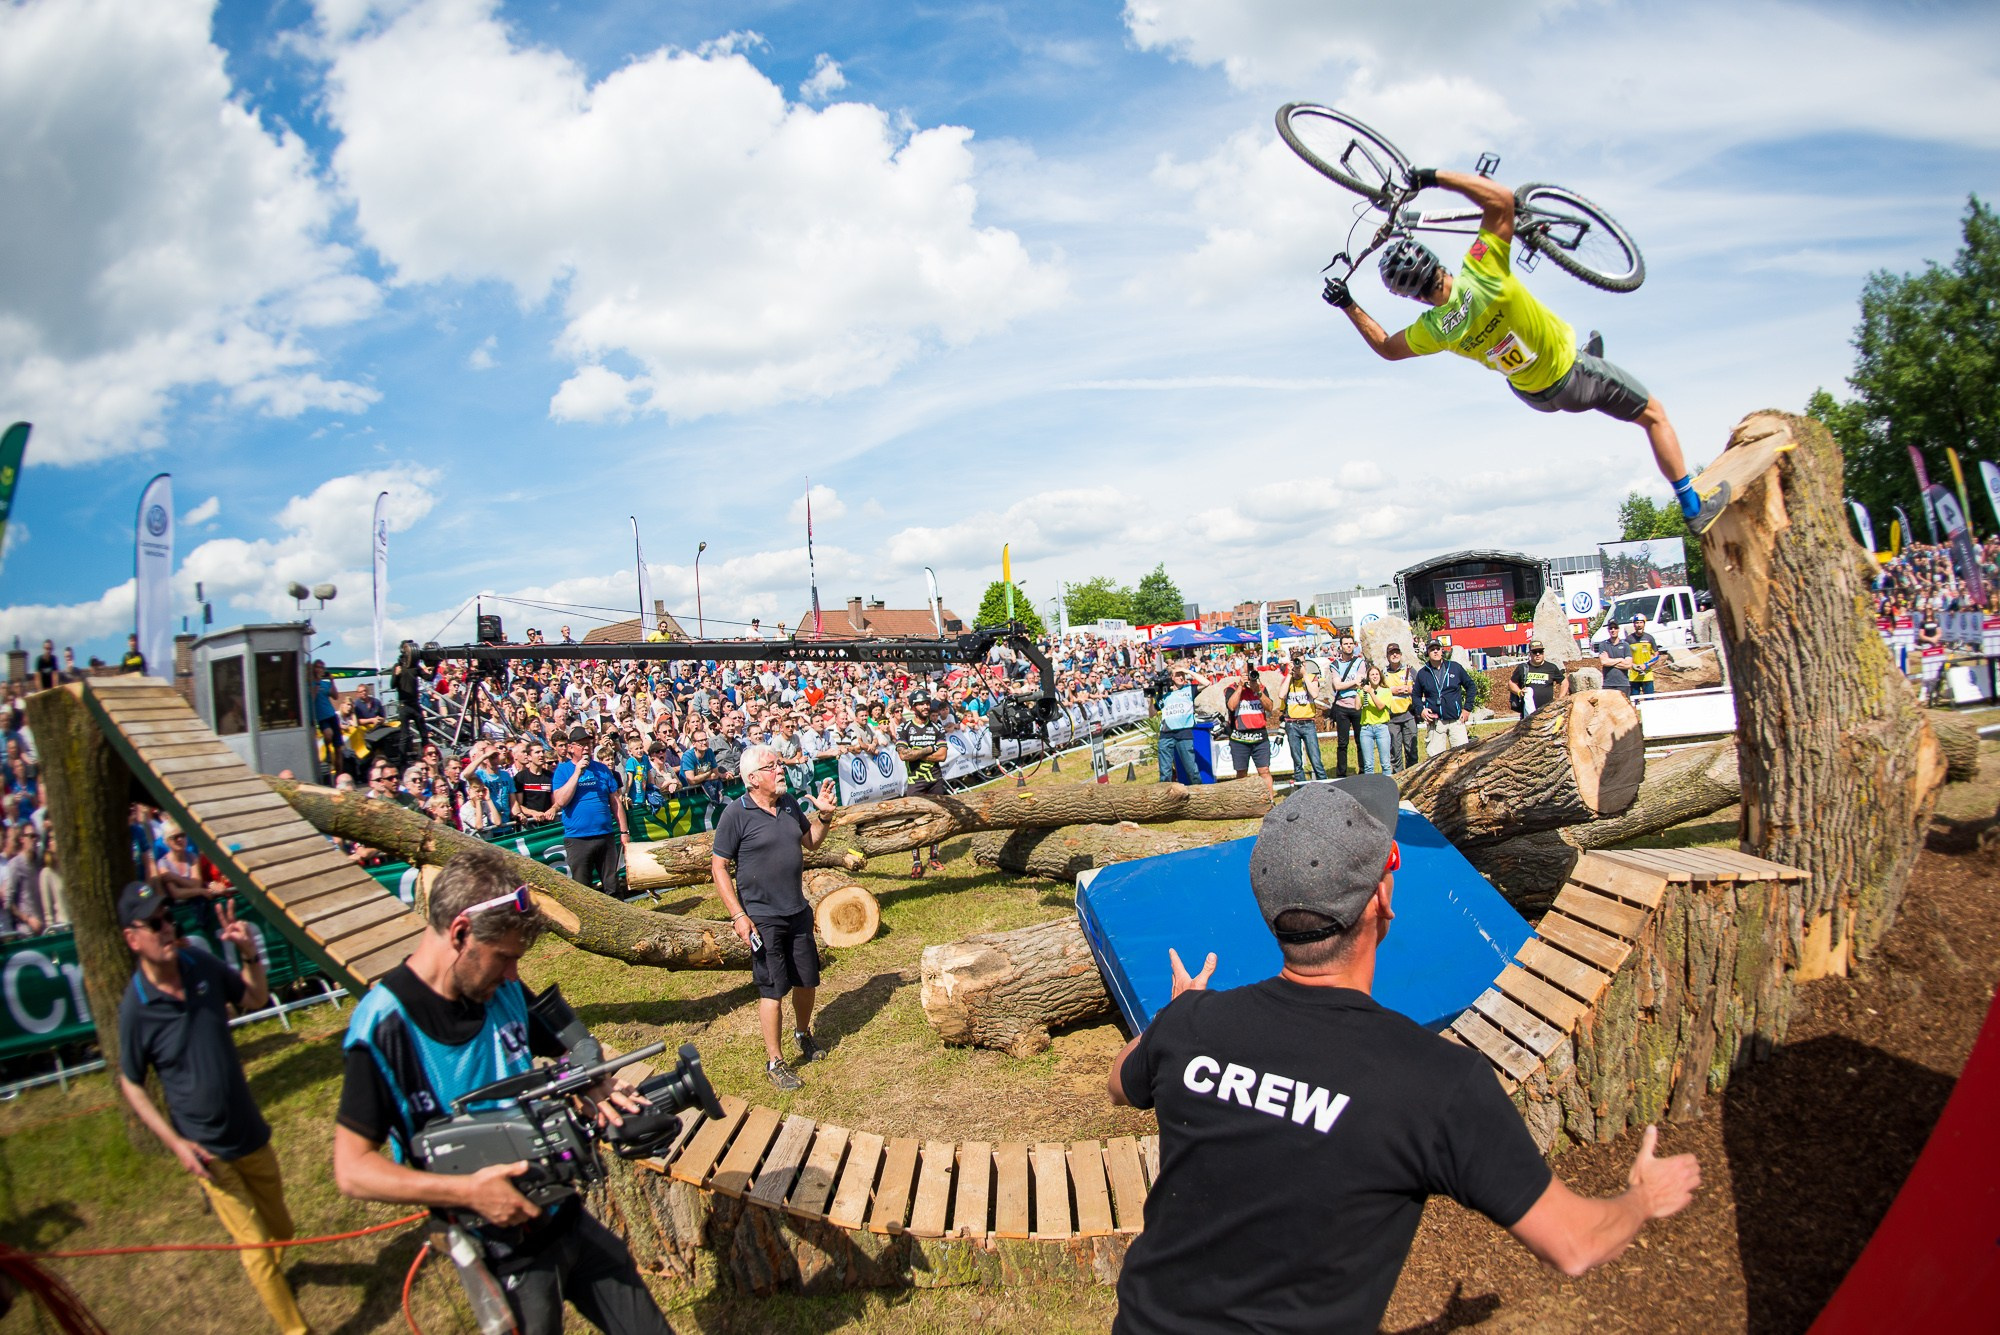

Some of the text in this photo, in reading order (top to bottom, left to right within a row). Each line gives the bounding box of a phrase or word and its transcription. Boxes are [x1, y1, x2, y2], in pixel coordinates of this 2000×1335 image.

[1464, 309, 1505, 352] FACTORY
[1501, 348, 1523, 367] 10
[1943, 503, 1956, 525] 4
[851, 787, 873, 798] Commercial
[1183, 1055, 1351, 1134] CREW
